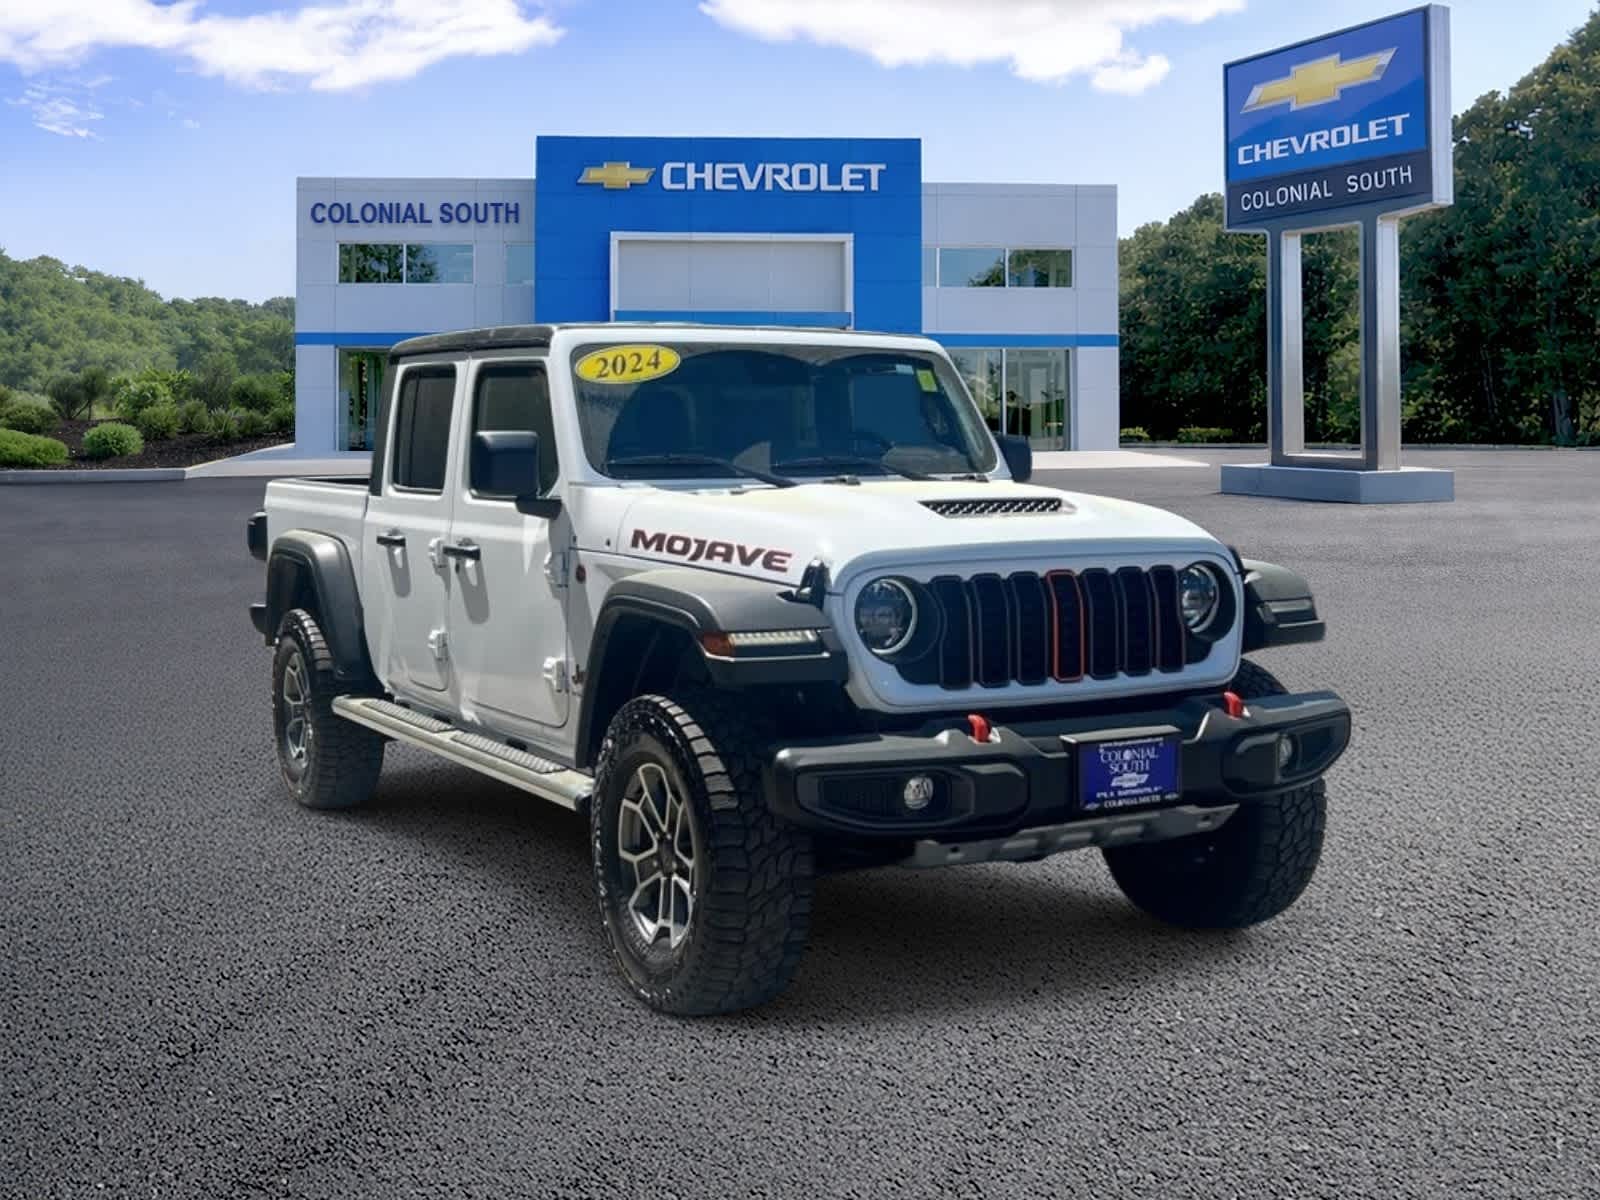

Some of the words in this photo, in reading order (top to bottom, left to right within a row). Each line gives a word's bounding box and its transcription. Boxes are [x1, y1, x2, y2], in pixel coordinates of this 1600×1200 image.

[1238, 113, 1410, 165] CHEVROLET
[661, 161, 887, 192] CHEVROLET
[1241, 180, 1333, 211] COLONIAL
[1346, 165, 1413, 194] SOUTH
[310, 202, 433, 225] COLONIAL
[439, 202, 521, 225] SOUTH
[595, 348, 663, 379] 2024
[631, 529, 793, 573] MOJAVE
[1100, 746, 1160, 763] COLONIAL
[1109, 759, 1151, 775] SOUTH
